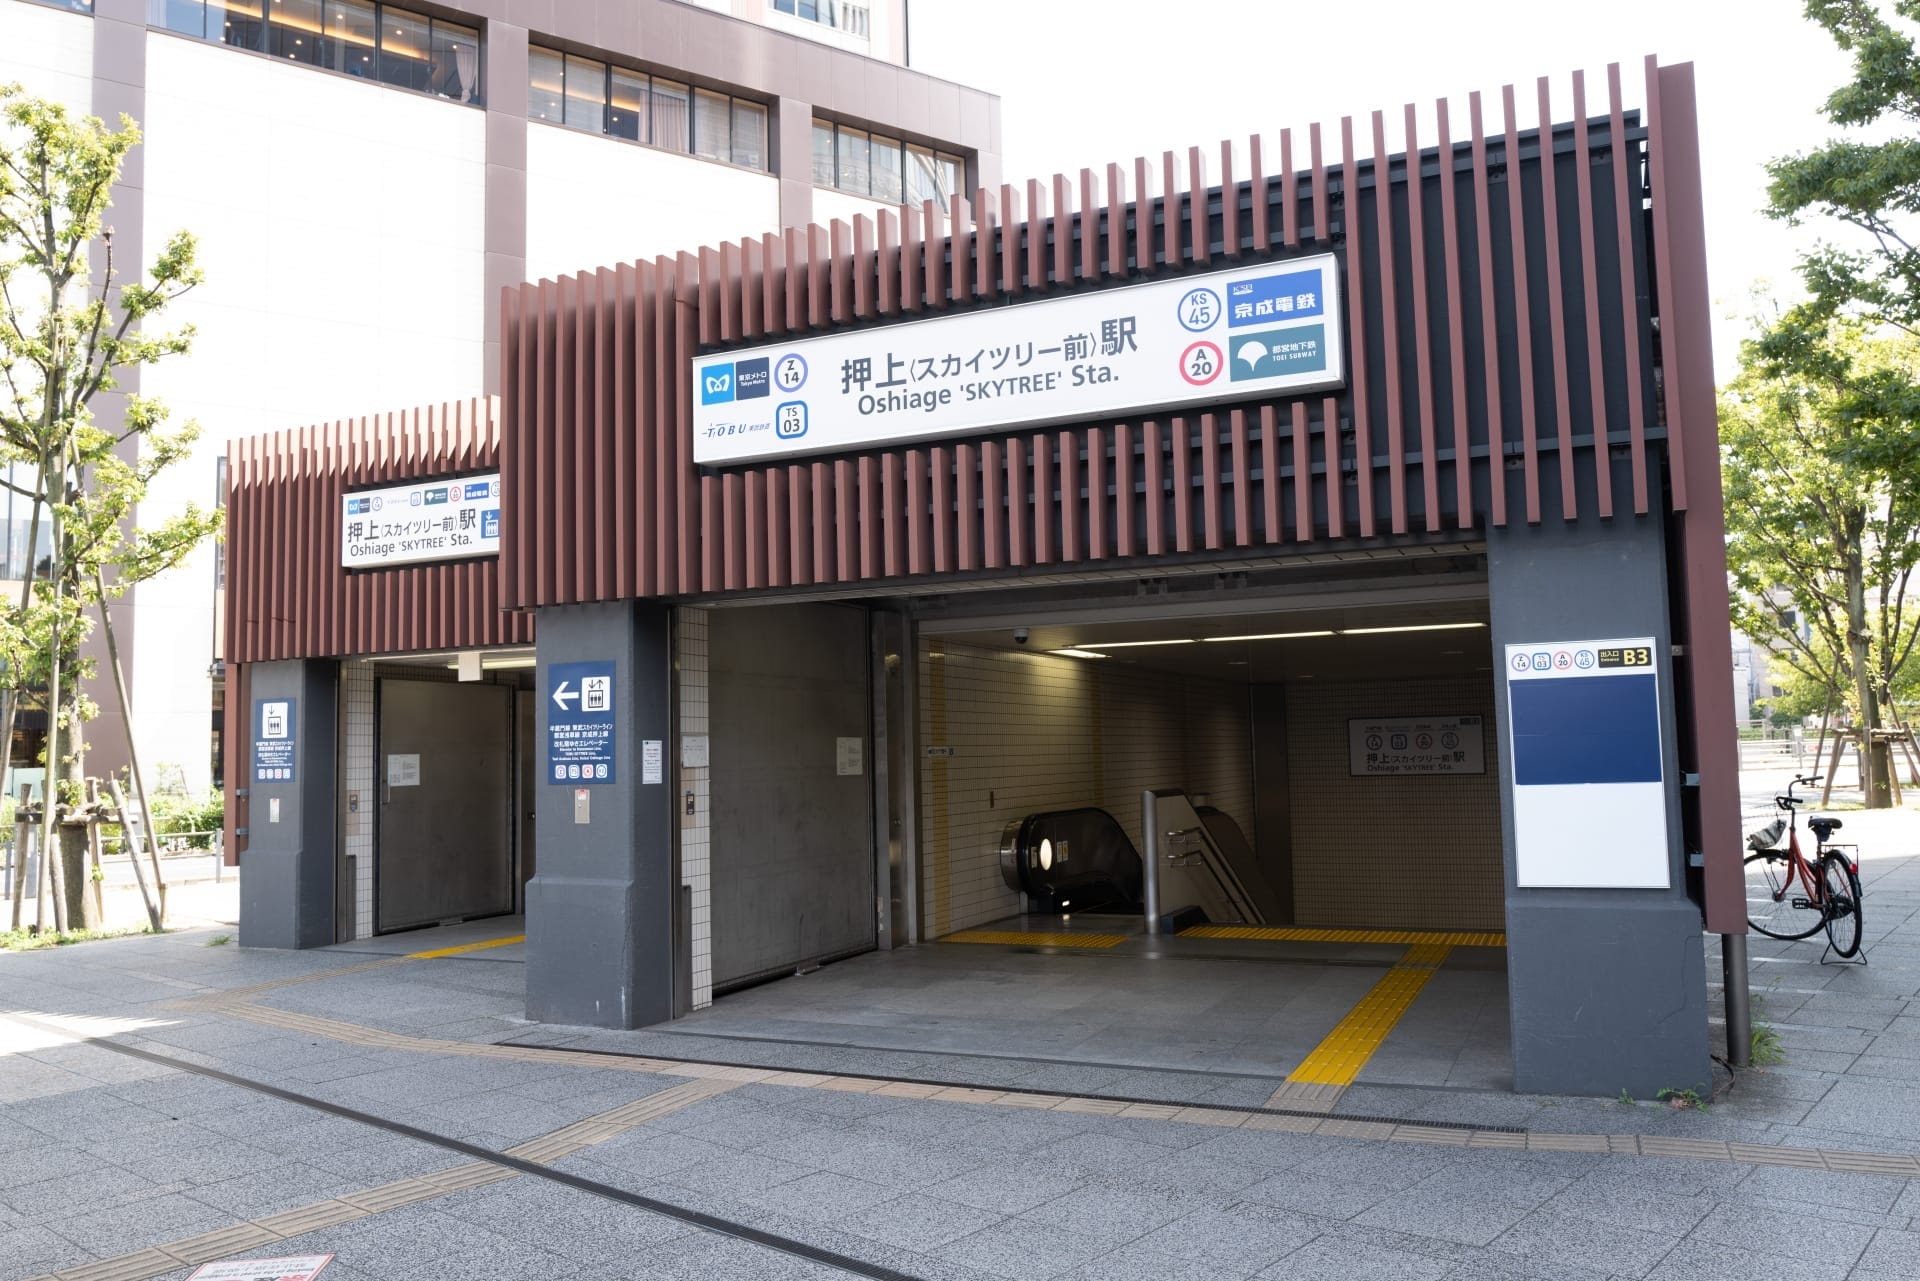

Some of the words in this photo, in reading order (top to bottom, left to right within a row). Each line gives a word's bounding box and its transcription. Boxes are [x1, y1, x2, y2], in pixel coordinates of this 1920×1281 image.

[1191, 293, 1207, 306] KS
[1234, 292, 1316, 319] 京成電鉄
[1188, 307, 1210, 325] 45
[1272, 340, 1316, 354] 都営地下鉄
[1195, 349, 1207, 361] A
[1289, 350, 1317, 360] SUBWAY
[787, 359, 795, 370] Z
[1191, 362, 1212, 376] 20
[739, 371, 767, 381] 東京メトロ
[784, 372, 800, 384] 14
[858, 387, 952, 416] Oshiage
[1071, 364, 1119, 387] Sta.
[786, 407, 798, 417] TS
[706, 423, 747, 438] TOBU
[783, 418, 800, 433] 03
[350, 542, 395, 556] Oshiage
[451, 533, 473, 546] Sta.
[1600, 650, 1620, 658] 出入口
[1623, 649, 1648, 665] B3
[1580, 658, 1590, 666] 45
[1367, 764, 1400, 773] Oshiage
